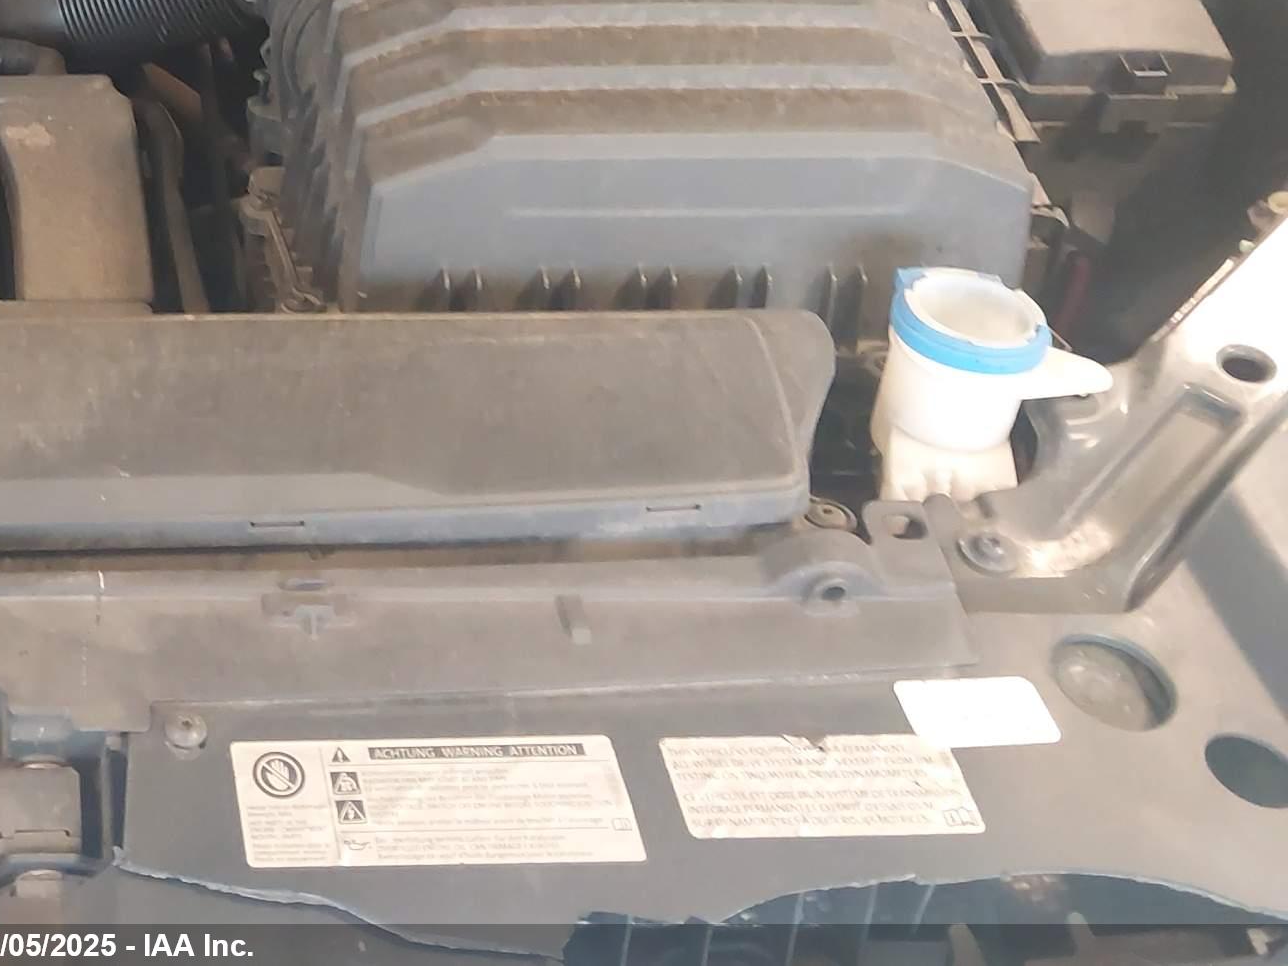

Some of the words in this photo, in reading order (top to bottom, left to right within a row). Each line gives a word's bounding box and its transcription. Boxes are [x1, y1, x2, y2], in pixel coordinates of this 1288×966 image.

[373, 746, 436, 760] ACHTUNG
[439, 745, 504, 758] WARNING
[509, 743, 578, 756] ATTENTION
